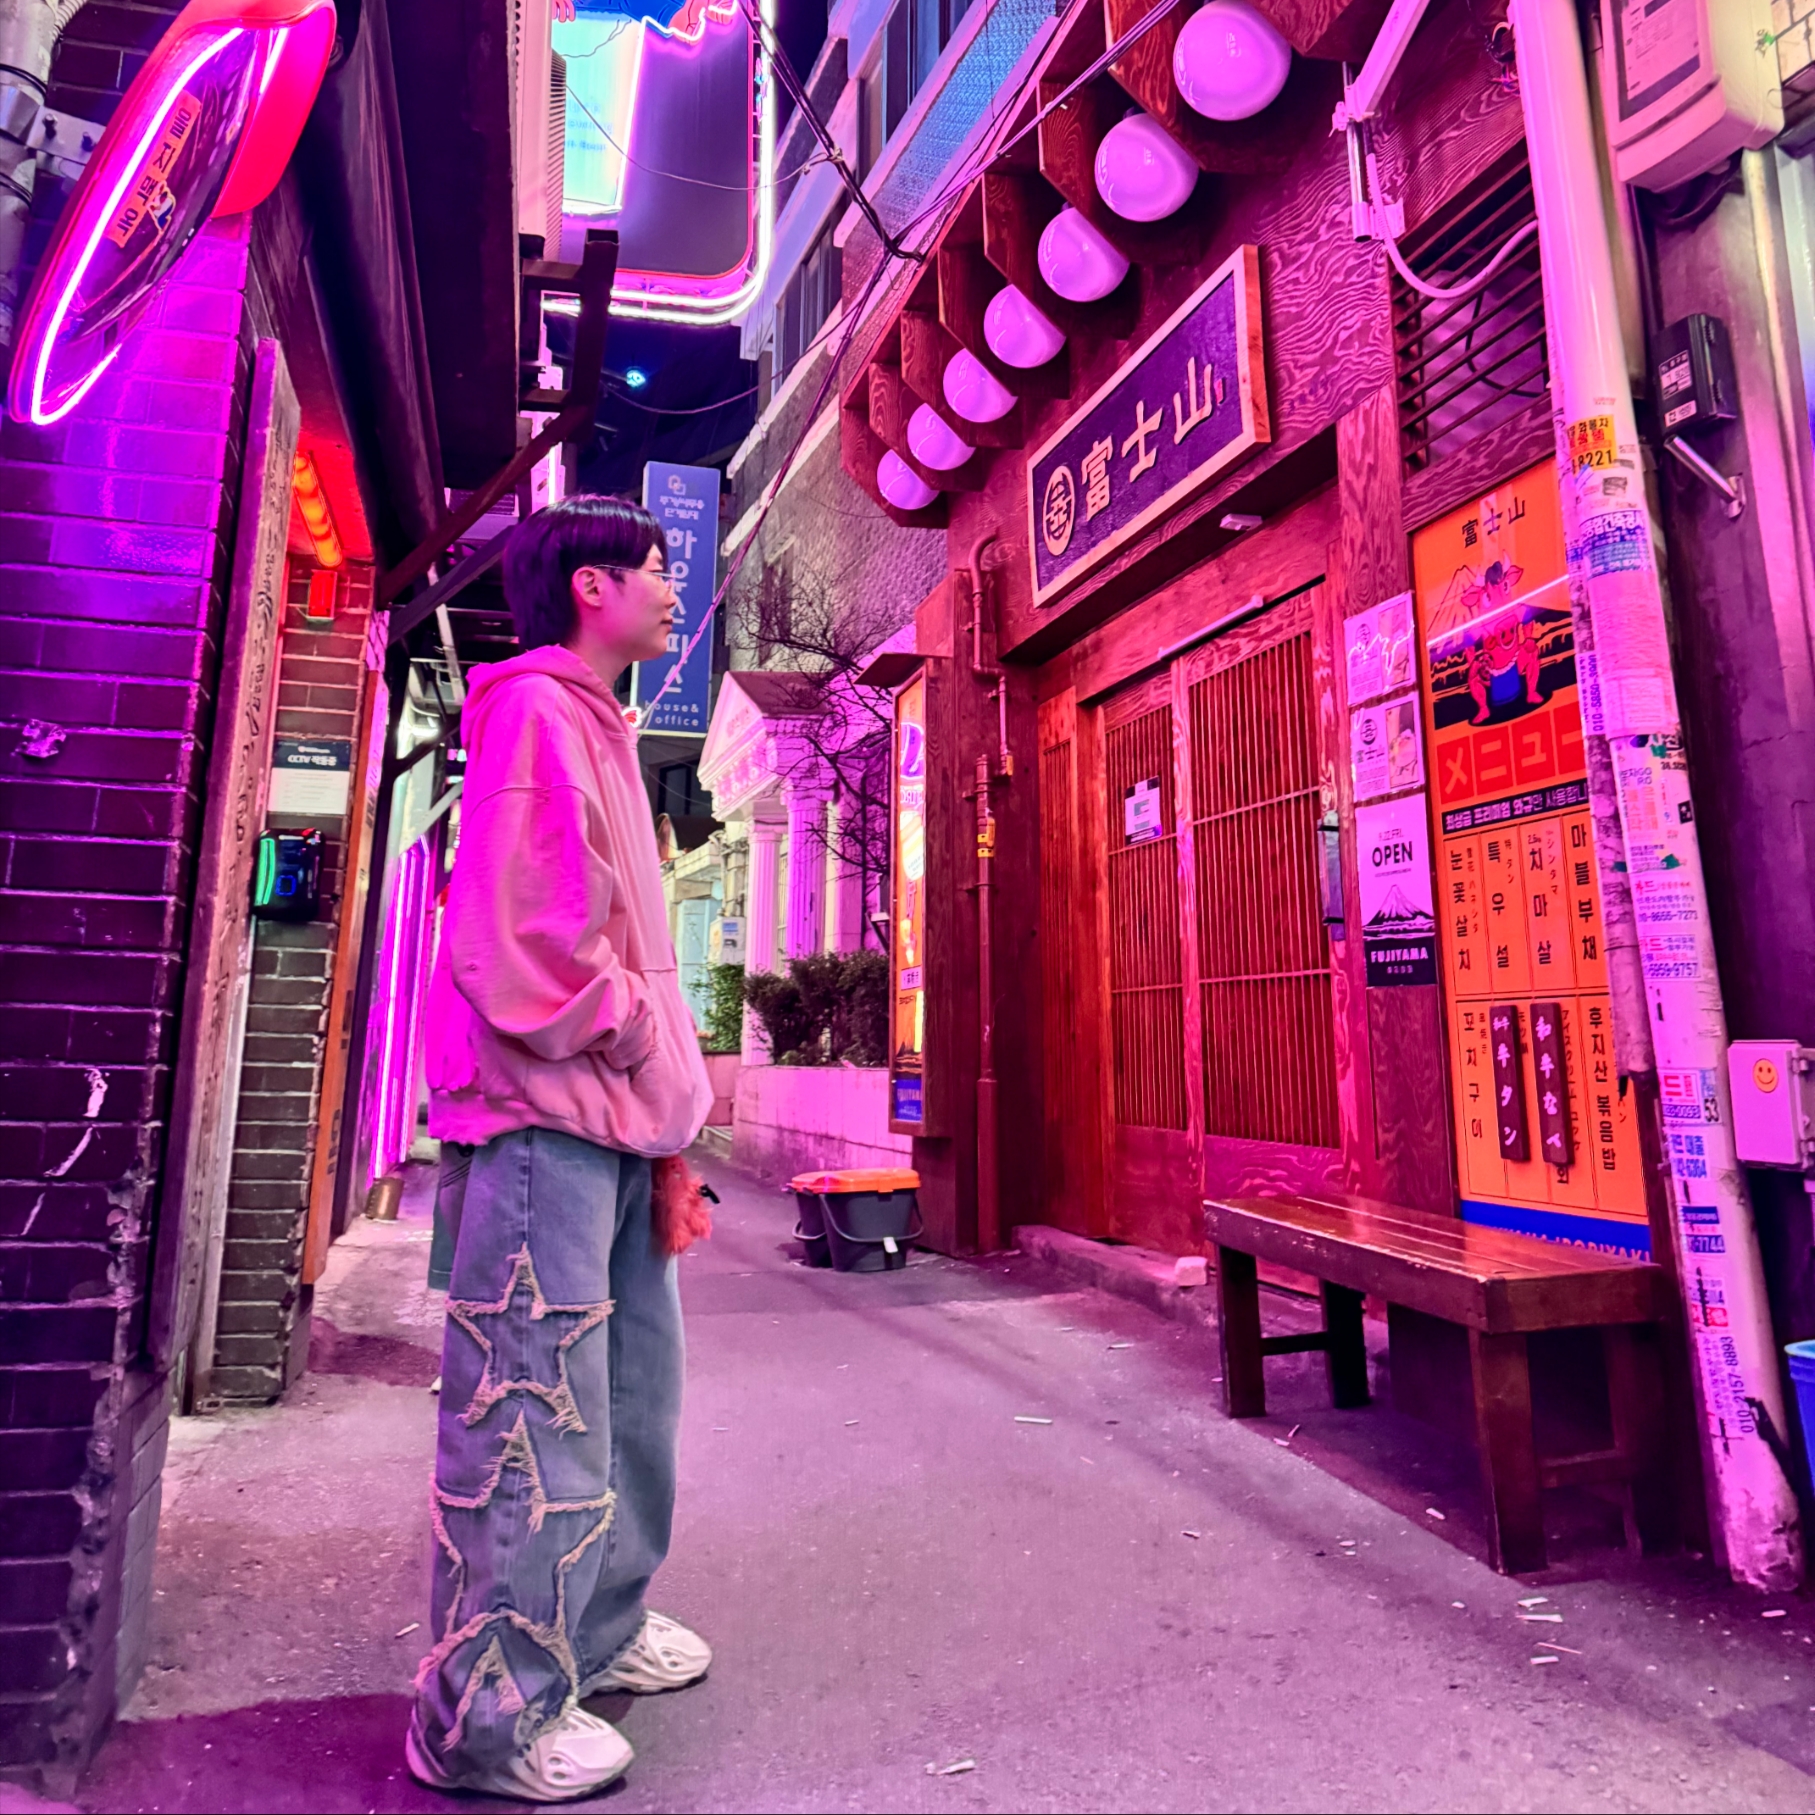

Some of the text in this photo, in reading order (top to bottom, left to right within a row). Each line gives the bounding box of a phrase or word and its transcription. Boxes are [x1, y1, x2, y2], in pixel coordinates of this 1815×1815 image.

[1081, 356, 1214, 522] 富士山
[1462, 496, 1526, 547] 富士山
[287, 754, 311, 764] CCTV
[655, 714, 699, 727] office
[1444, 731, 1585, 795] メニュー
[1372, 841, 1413, 867] OPEN
[1570, 824, 1598, 961] 마블부채
[1450, 850, 1471, 971] 눈꽃살치
[1488, 840, 1510, 968] 특우설
[1529, 848, 1552, 966] 치마살
[1370, 946, 1429, 964] FUJIYAMA
[1589, 1007, 1617, 1171] 후지산 볶음밥
